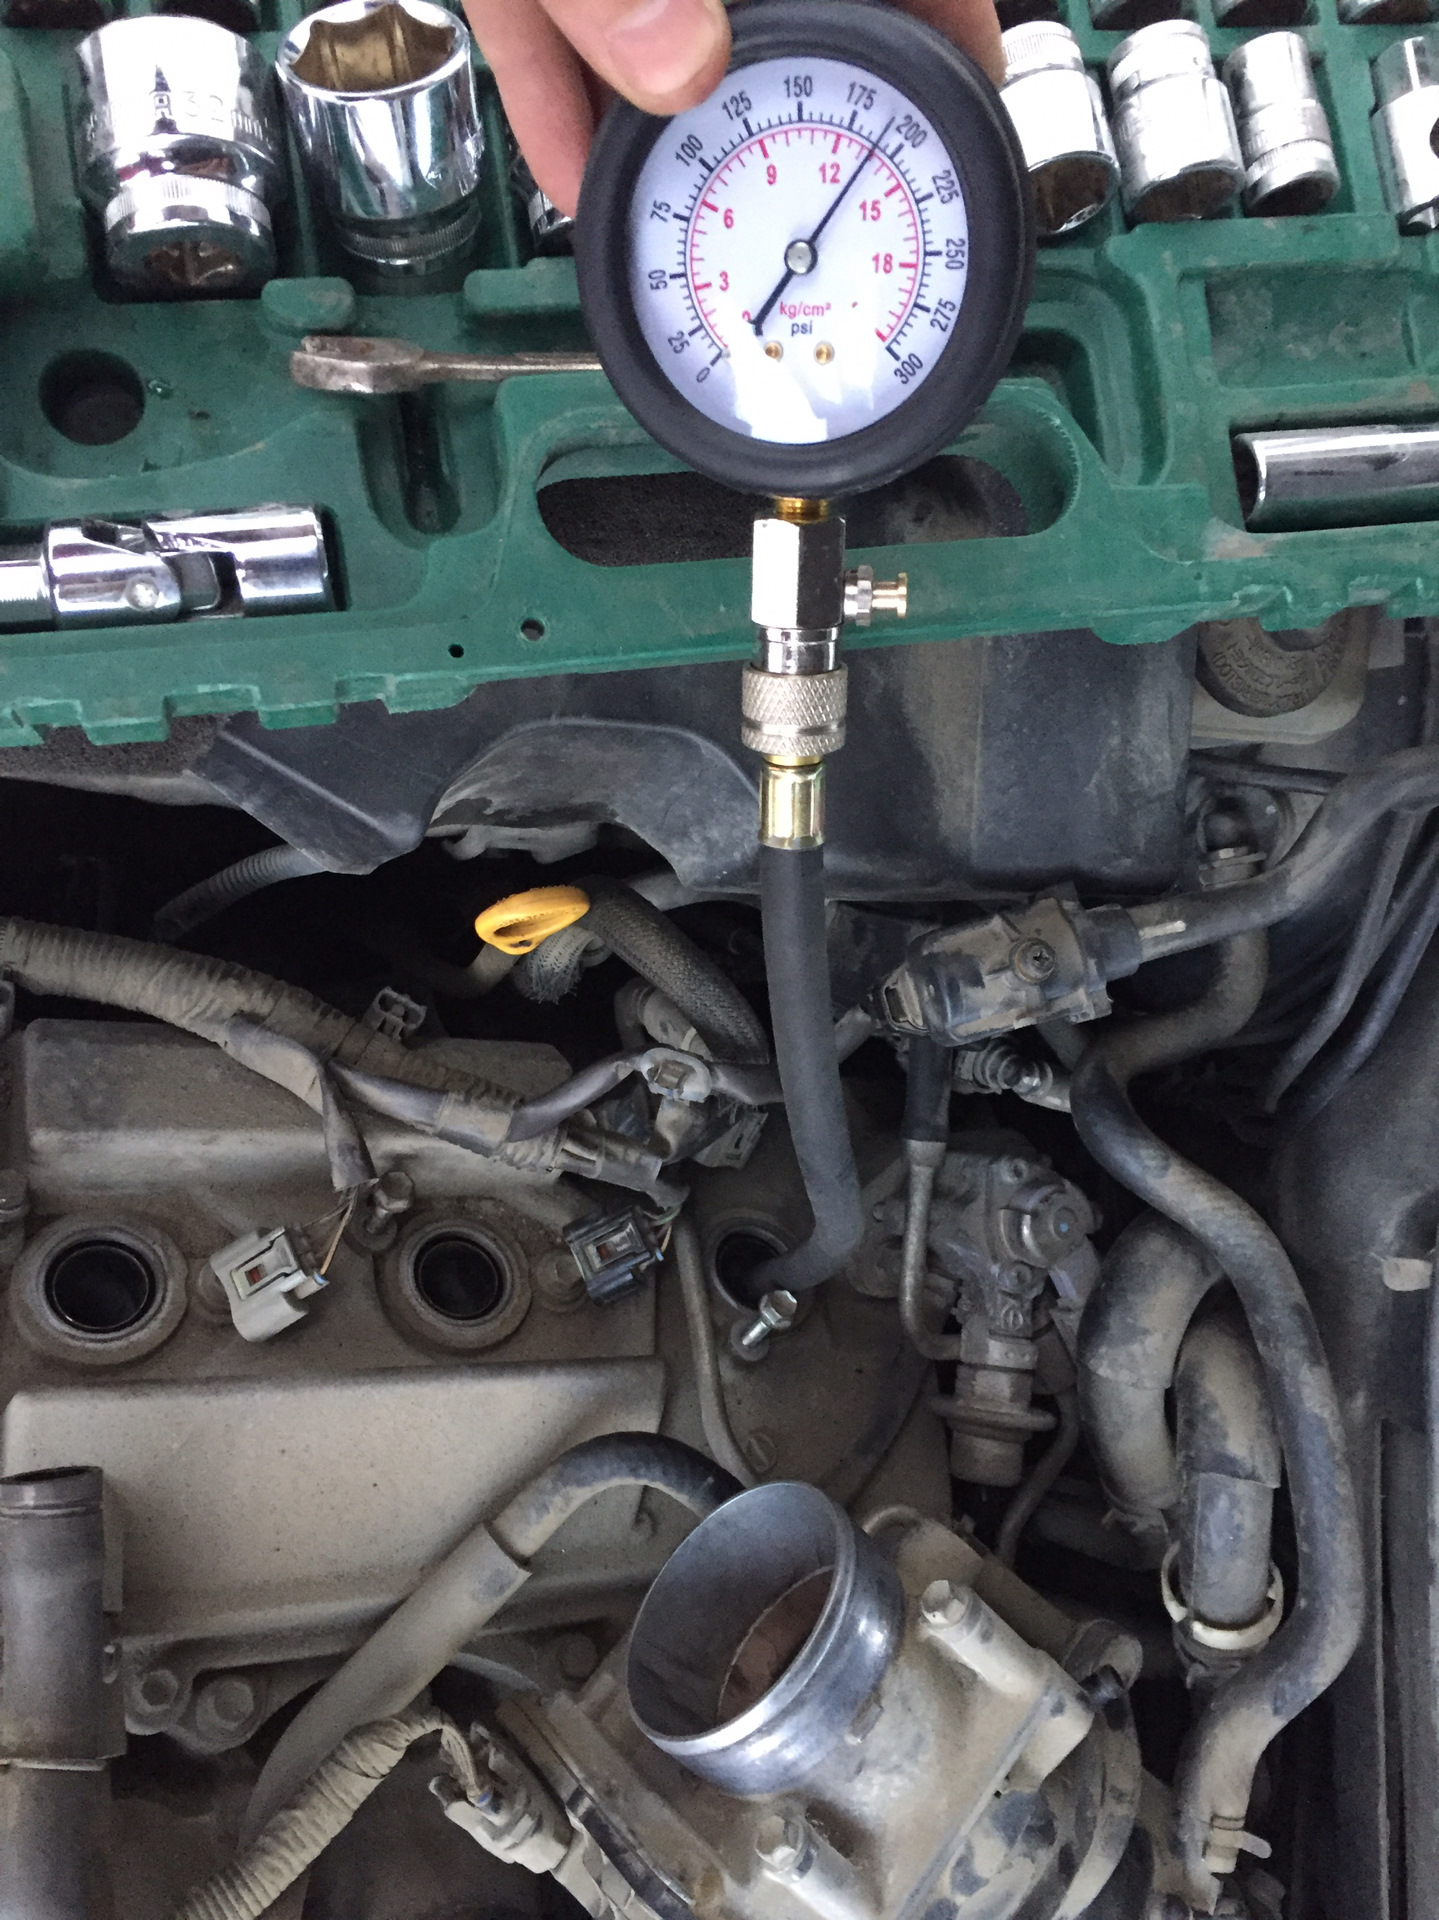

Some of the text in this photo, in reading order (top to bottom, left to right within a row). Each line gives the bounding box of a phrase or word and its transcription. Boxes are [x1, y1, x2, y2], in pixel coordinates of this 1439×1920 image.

[784, 75, 813, 98] 150
[846, 81, 877, 110] 175
[722, 90, 752, 121] 125
[895, 114, 928, 149] 200
[675, 134, 703, 167] 100
[766, 164, 777, 185] 9
[819, 162, 841, 184] 12
[932, 169, 960, 204] 225
[650, 200, 671, 223] 75
[723, 208, 734, 229] 6
[859, 199, 881, 221] 15
[872, 253, 893, 274] 18
[945, 238, 966, 270] 250
[648, 269, 667, 290] 50
[719, 271, 729, 291] 3
[930, 298, 957, 332] 275
[791, 320, 813, 337] psi
[667, 330, 690, 354] 25
[696, 367, 711, 383] 0
[894, 353, 923, 385] 300
